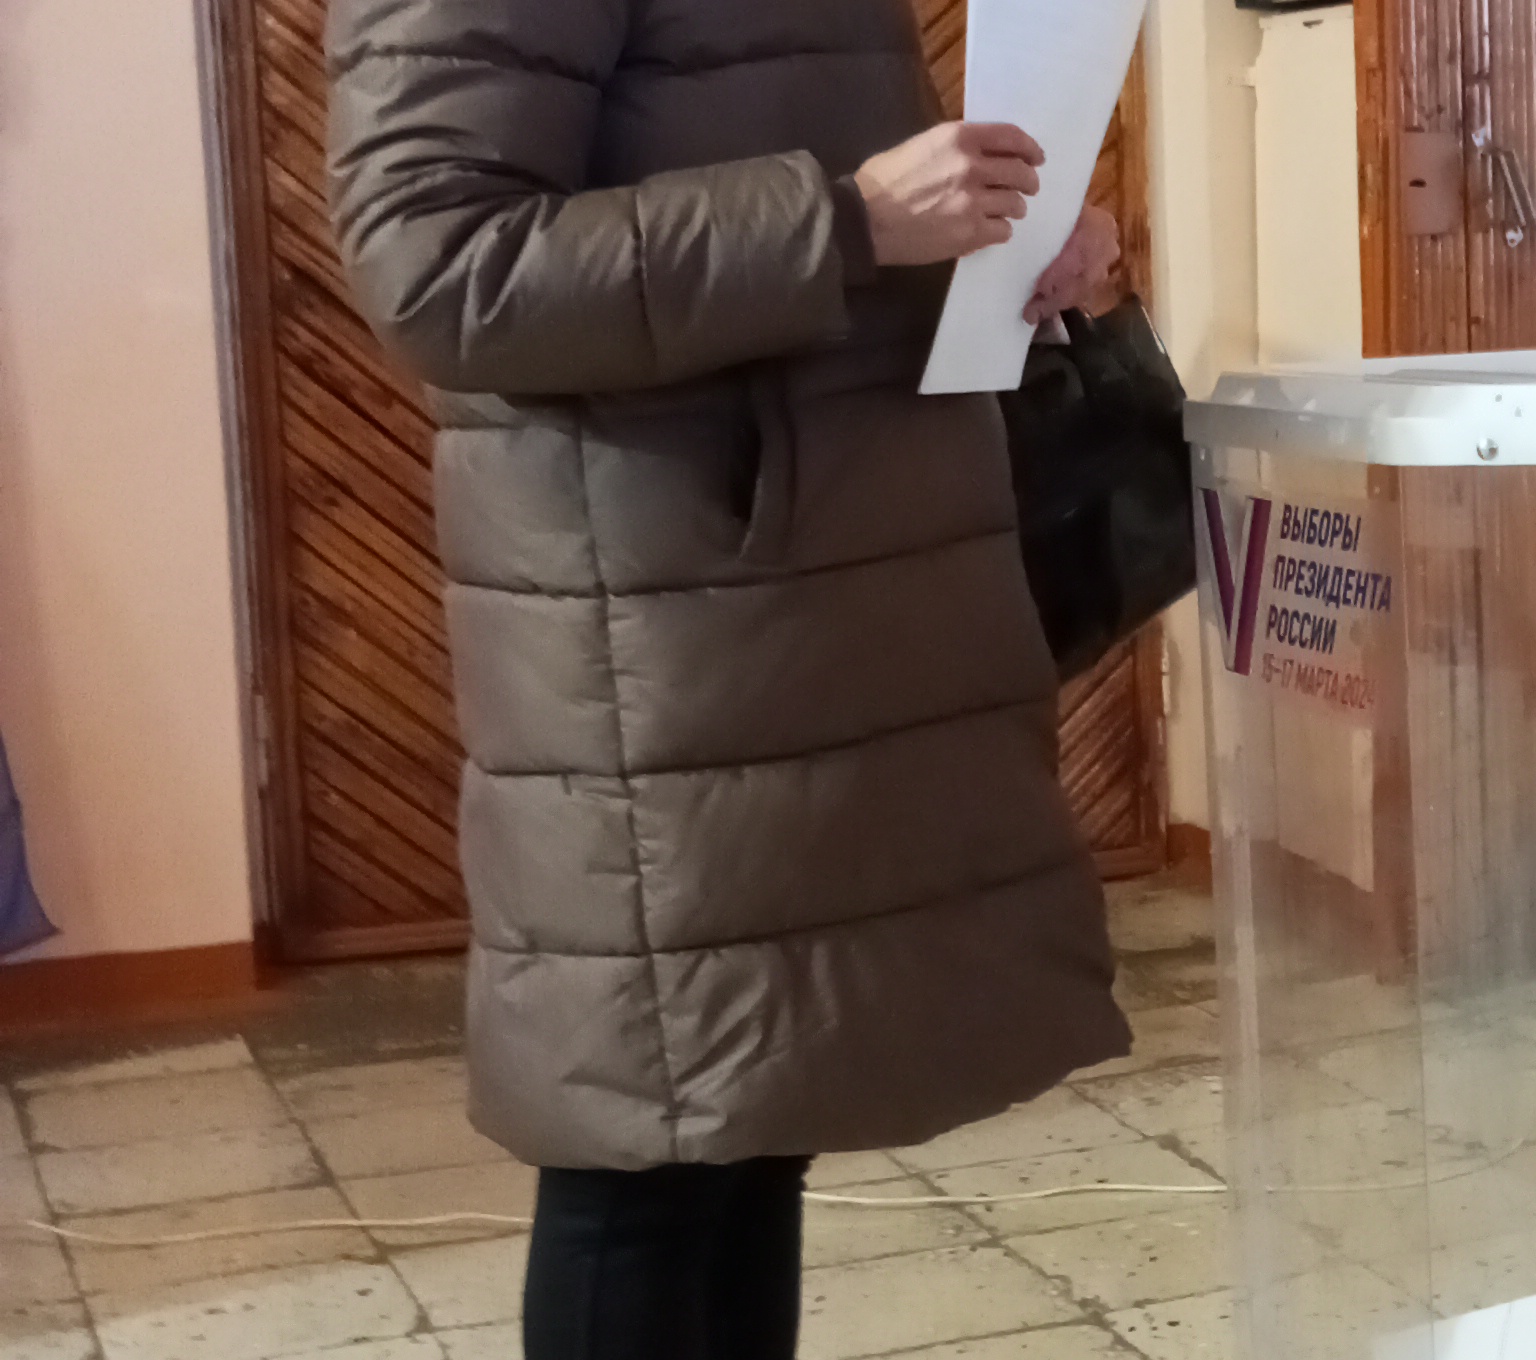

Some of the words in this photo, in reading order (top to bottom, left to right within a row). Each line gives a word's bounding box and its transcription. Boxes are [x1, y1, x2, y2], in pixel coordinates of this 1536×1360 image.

[1280, 504, 1361, 551] ВЫБОРЫ
[1273, 555, 1392, 611] ПРЕЗИДЕНТА
[1265, 604, 1337, 655] РОССИИ
[1295, 663, 1339, 702] МАРТА
